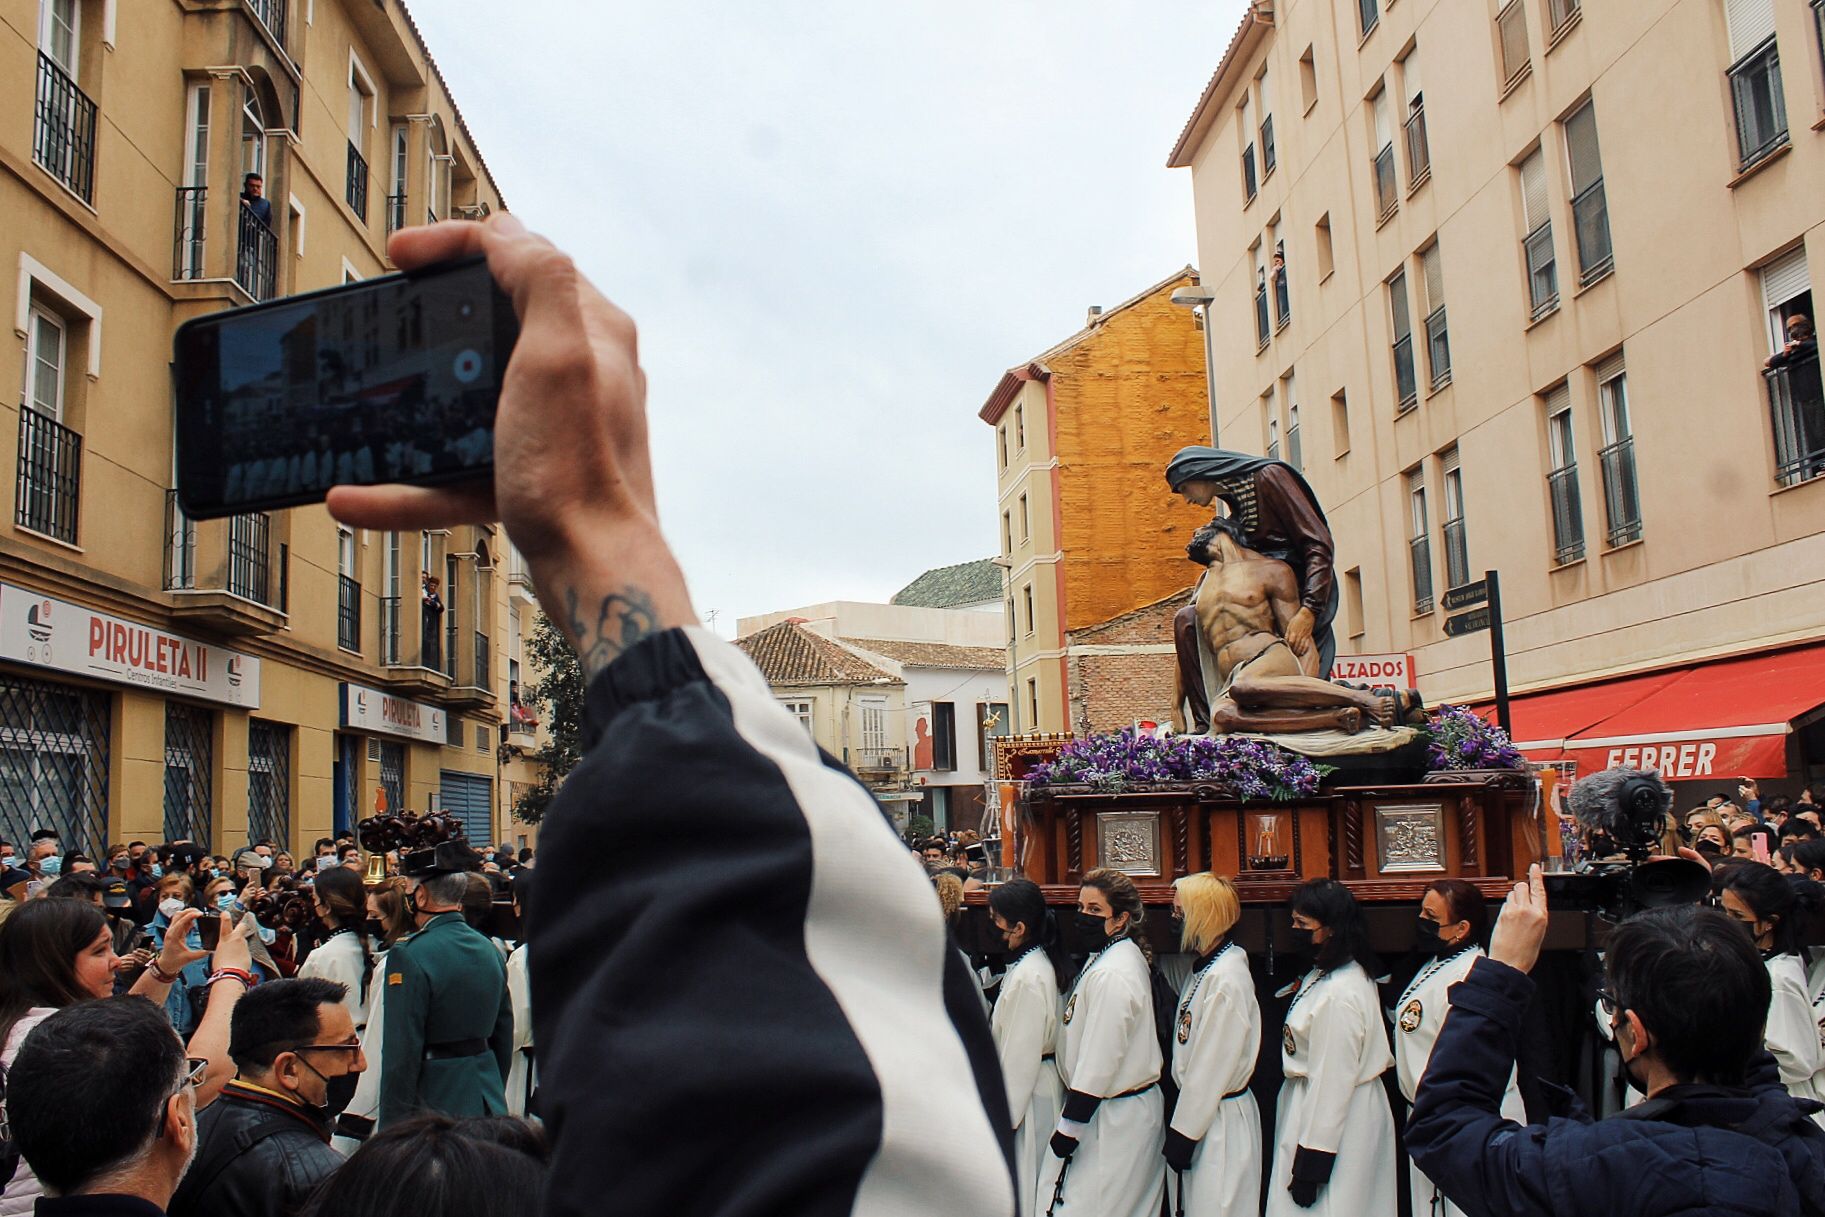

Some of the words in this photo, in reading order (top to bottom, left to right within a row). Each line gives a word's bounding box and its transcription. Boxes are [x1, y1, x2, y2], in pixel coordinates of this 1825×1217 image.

[89, 616, 191, 679] PIRULETA
[196, 646, 207, 682] II
[127, 668, 150, 684] Centros
[151, 673, 177, 689] Infantiles
[382, 697, 421, 729] PIRULETA
